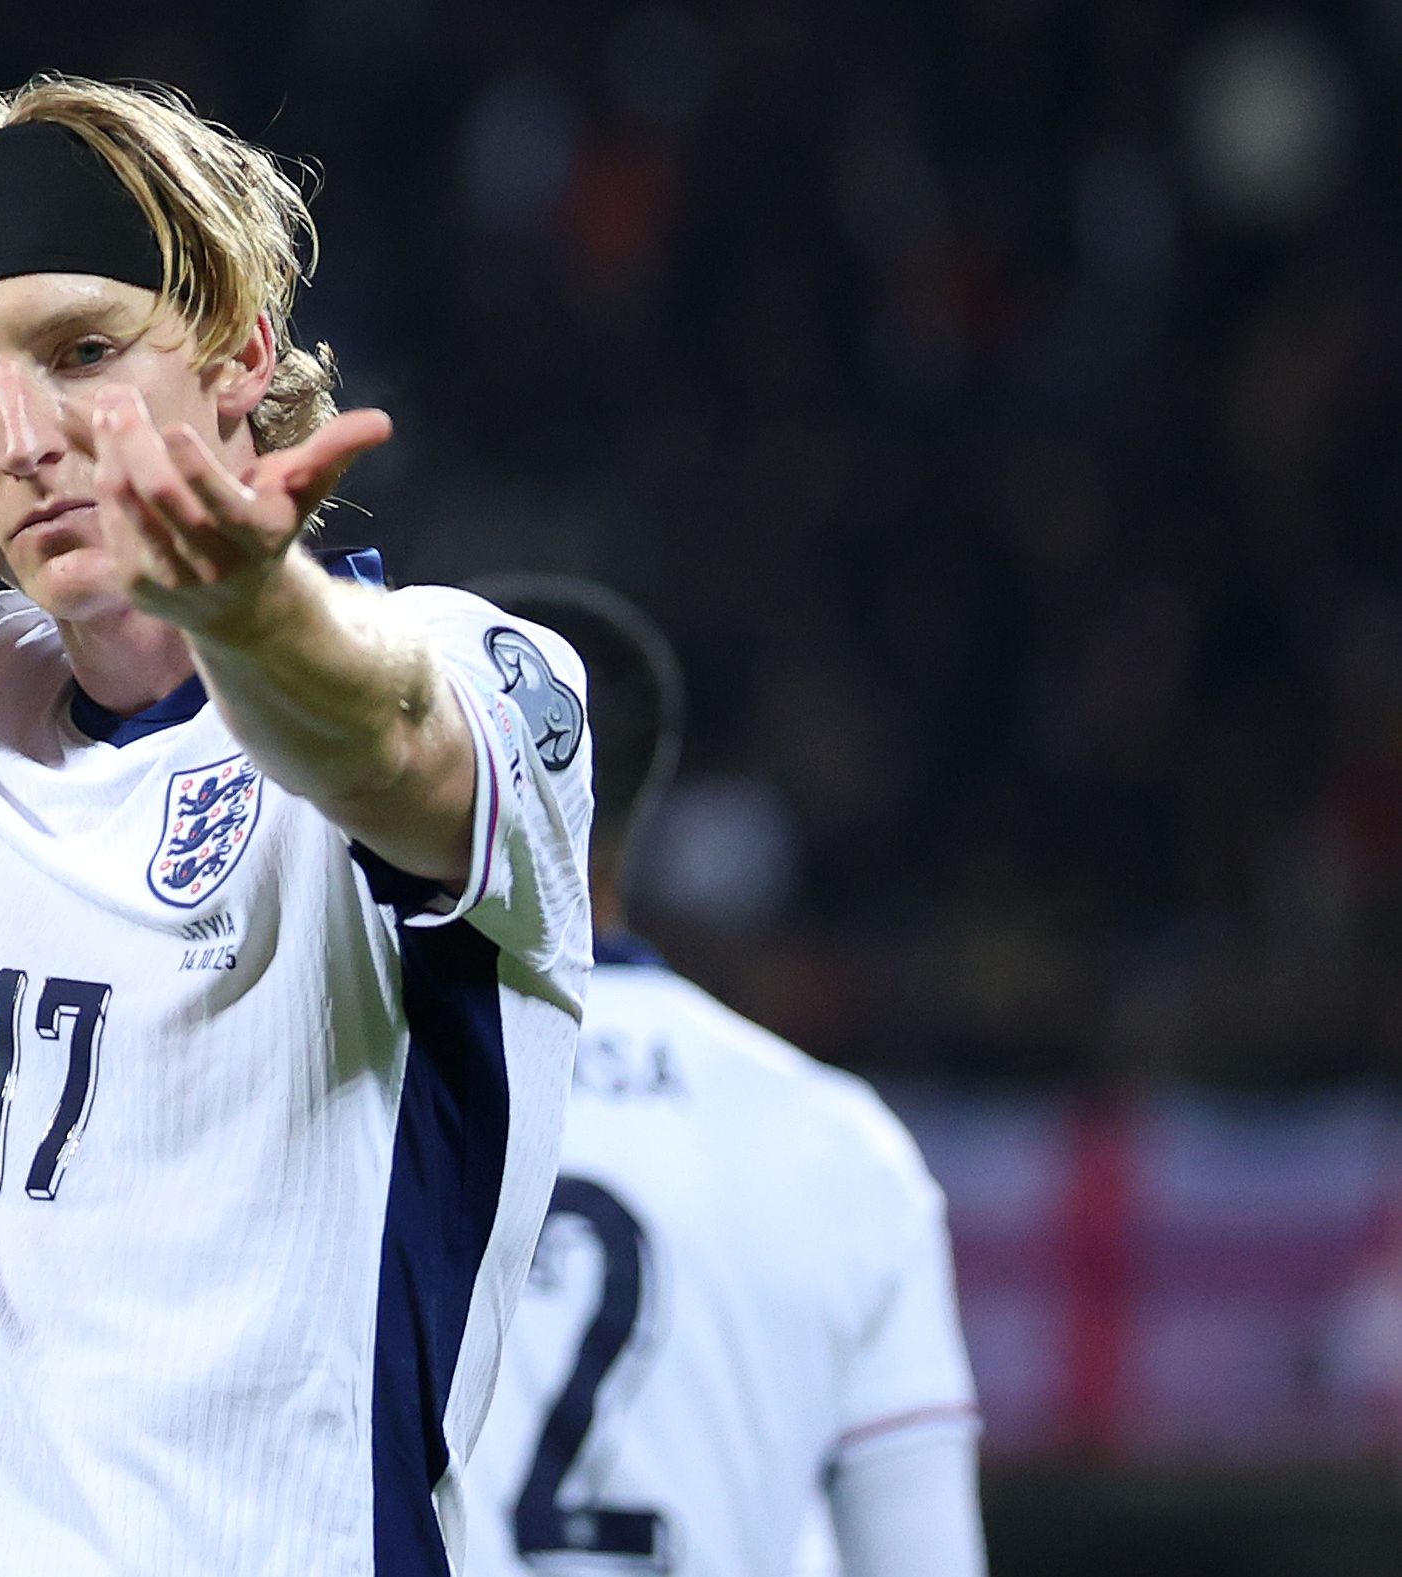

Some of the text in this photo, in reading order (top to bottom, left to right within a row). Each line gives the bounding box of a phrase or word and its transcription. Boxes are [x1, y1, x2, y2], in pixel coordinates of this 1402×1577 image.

[181, 911, 236, 940] LATVIA
[178, 945, 237, 971] 14.10.25
[573, 1032, 688, 1098] SA
[512, 1174, 665, 1570] 2
